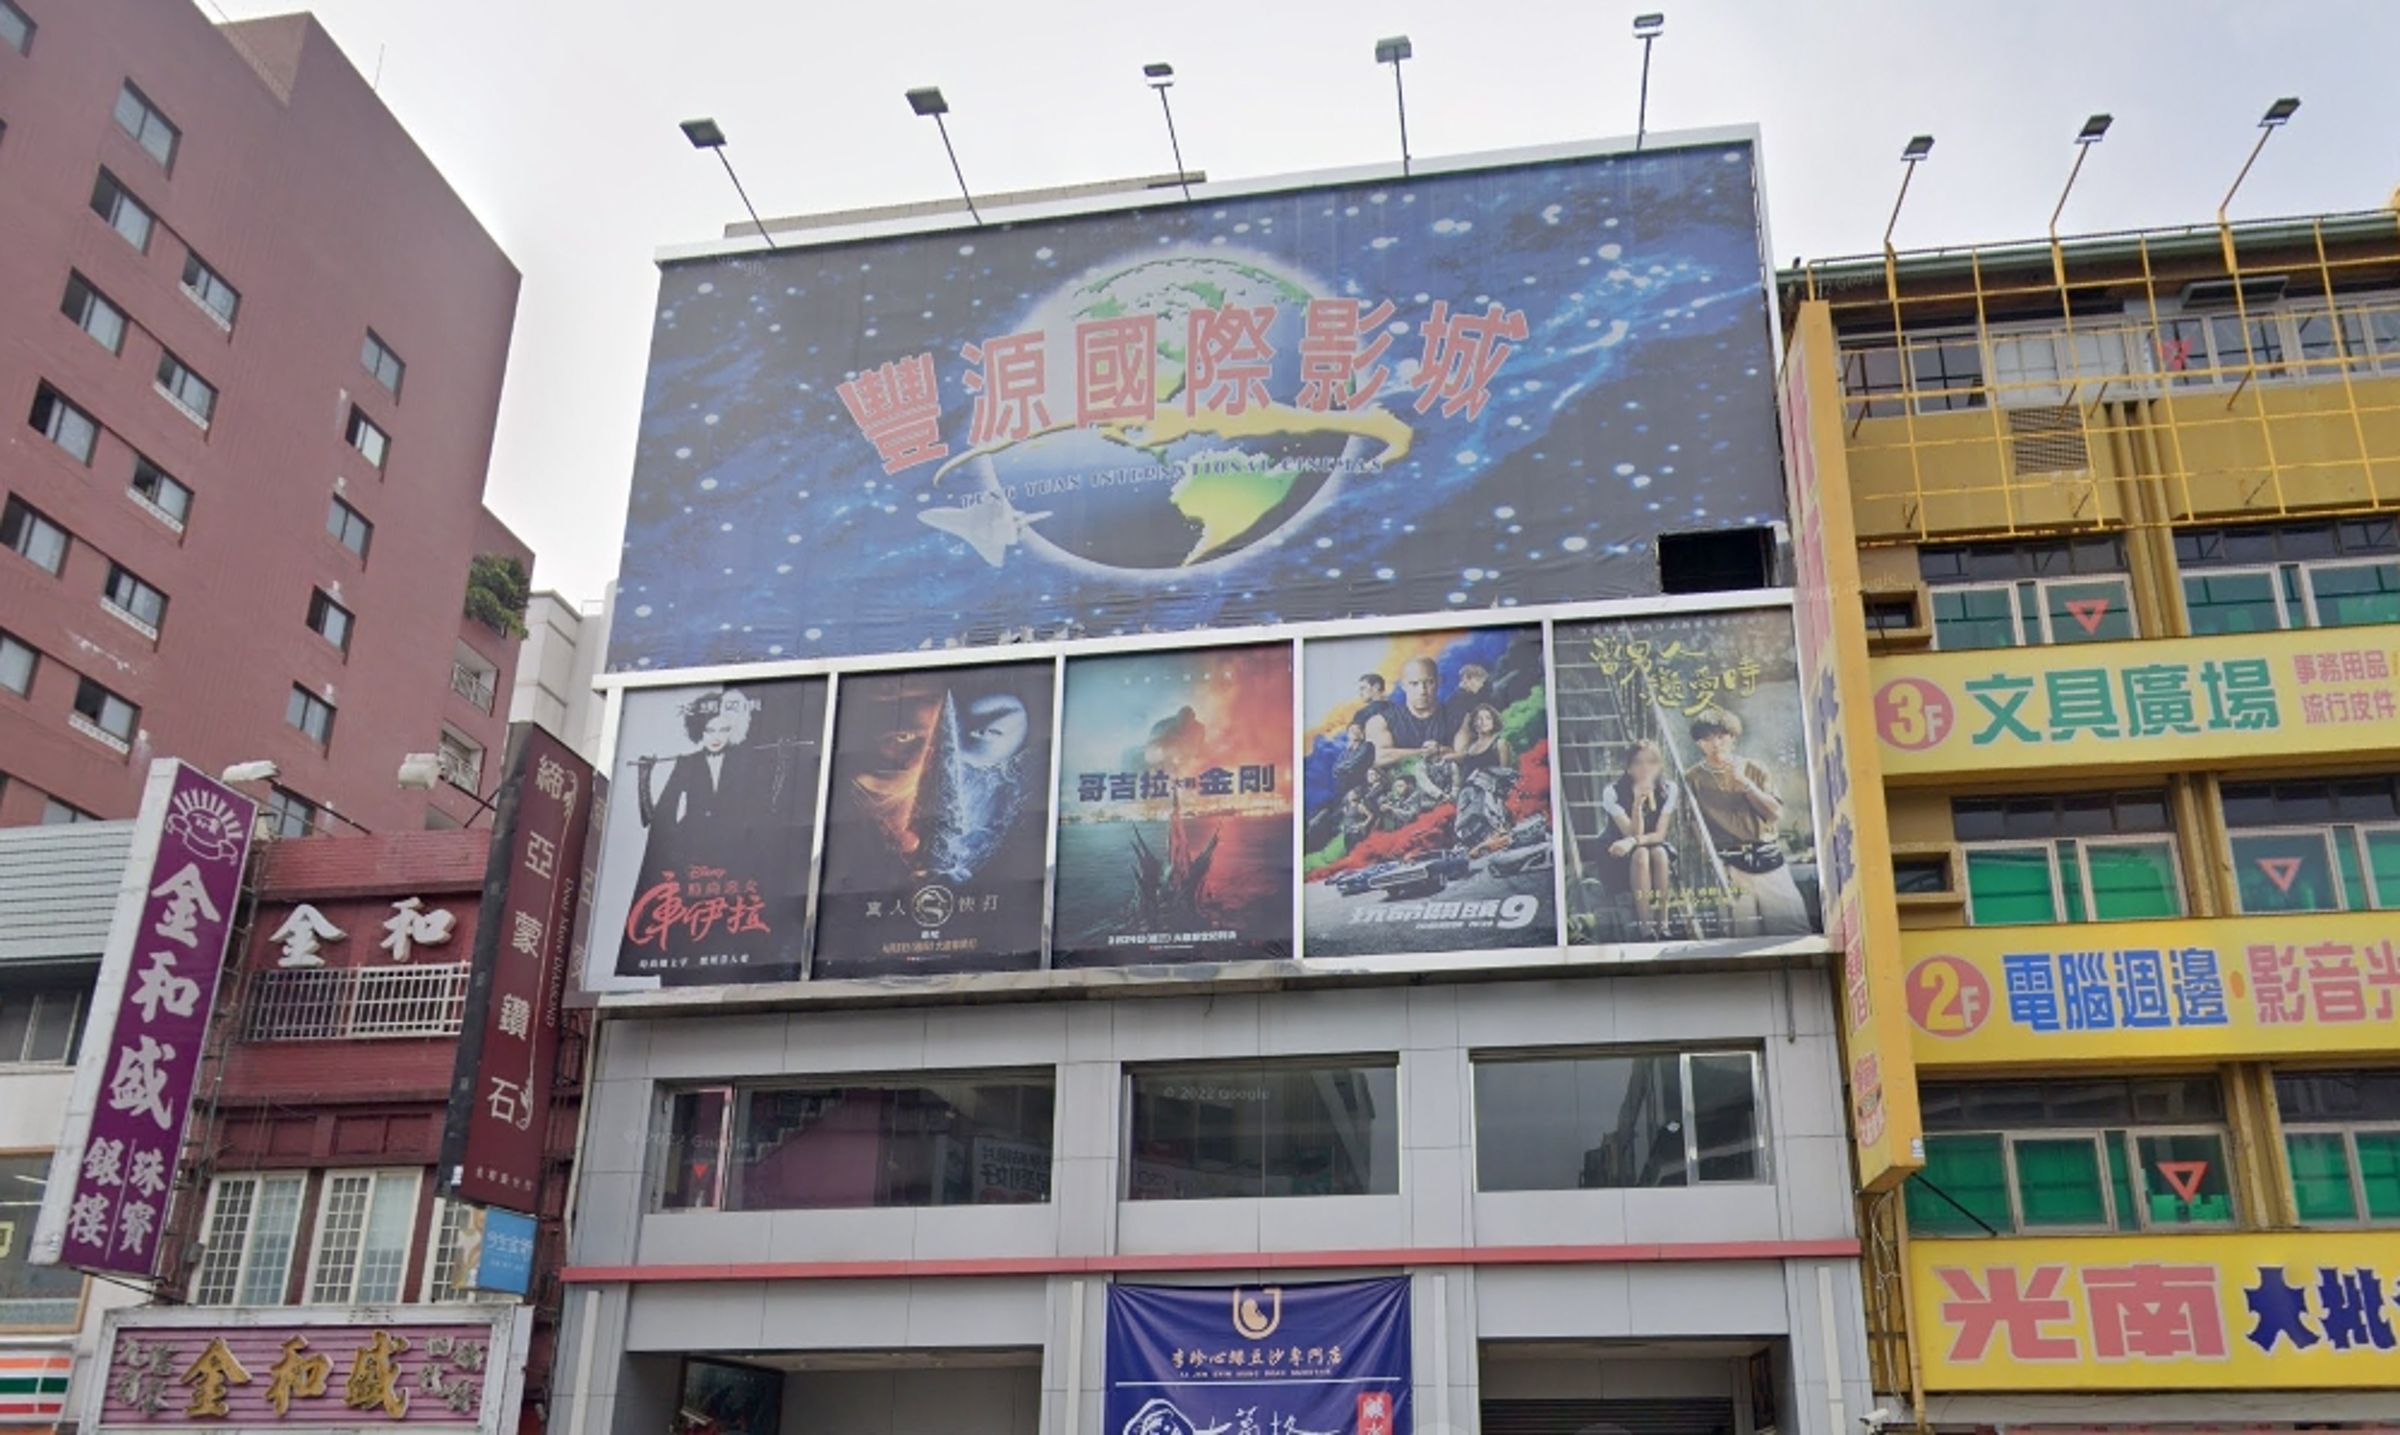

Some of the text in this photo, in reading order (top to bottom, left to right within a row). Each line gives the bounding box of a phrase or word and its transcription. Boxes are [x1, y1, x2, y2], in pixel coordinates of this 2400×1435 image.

[836, 298, 1528, 474] 豐源國際影城
[1887, 657, 2281, 745] 3F 文具廣場
[2294, 650, 2389, 685] 事務用品
[2302, 690, 2396, 724] 流行皮件
[269, 897, 458, 968] 金和
[108, 862, 222, 1131] 金和盛
[1919, 961, 1982, 1031] 2F
[2002, 948, 2229, 1032] 電腦週邊
[69, 1136, 124, 1247] 銀樓
[1934, 1263, 2400, 1363] 光南 大批
[180, 1330, 411, 1420] 金和盛
